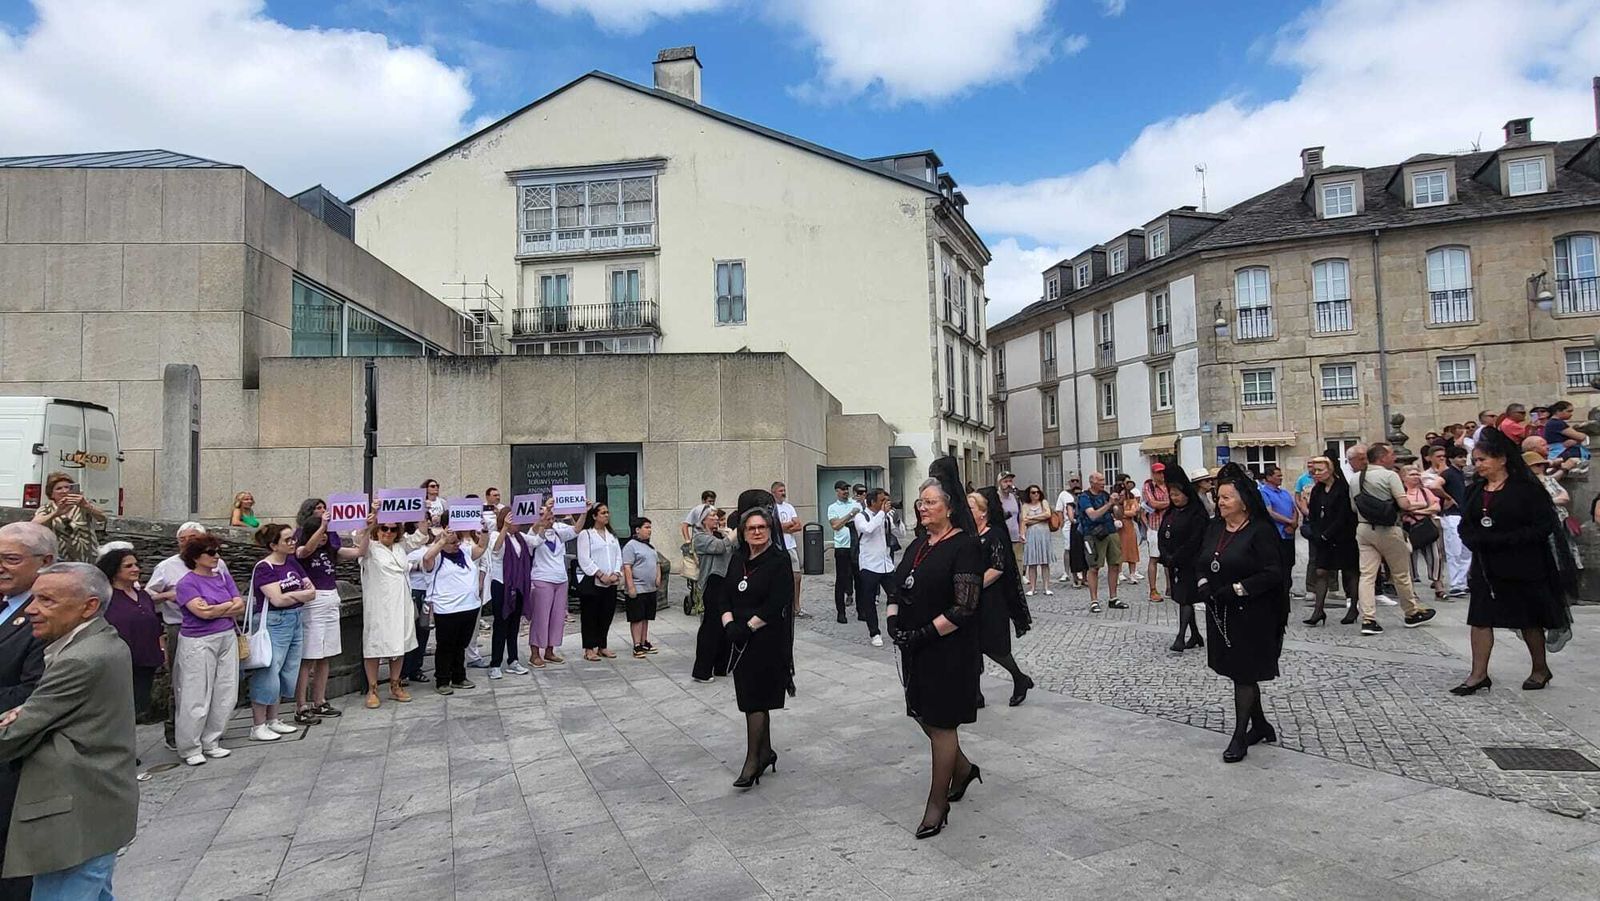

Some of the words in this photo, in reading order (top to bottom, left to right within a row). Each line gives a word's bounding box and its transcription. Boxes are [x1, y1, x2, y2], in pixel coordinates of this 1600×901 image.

[382, 498, 422, 511] MAIS
[556, 495, 586, 504] IGREXA
[332, 504, 367, 520] NON
[450, 510, 480, 518] ABUSOS
[516, 501, 536, 516] NA
